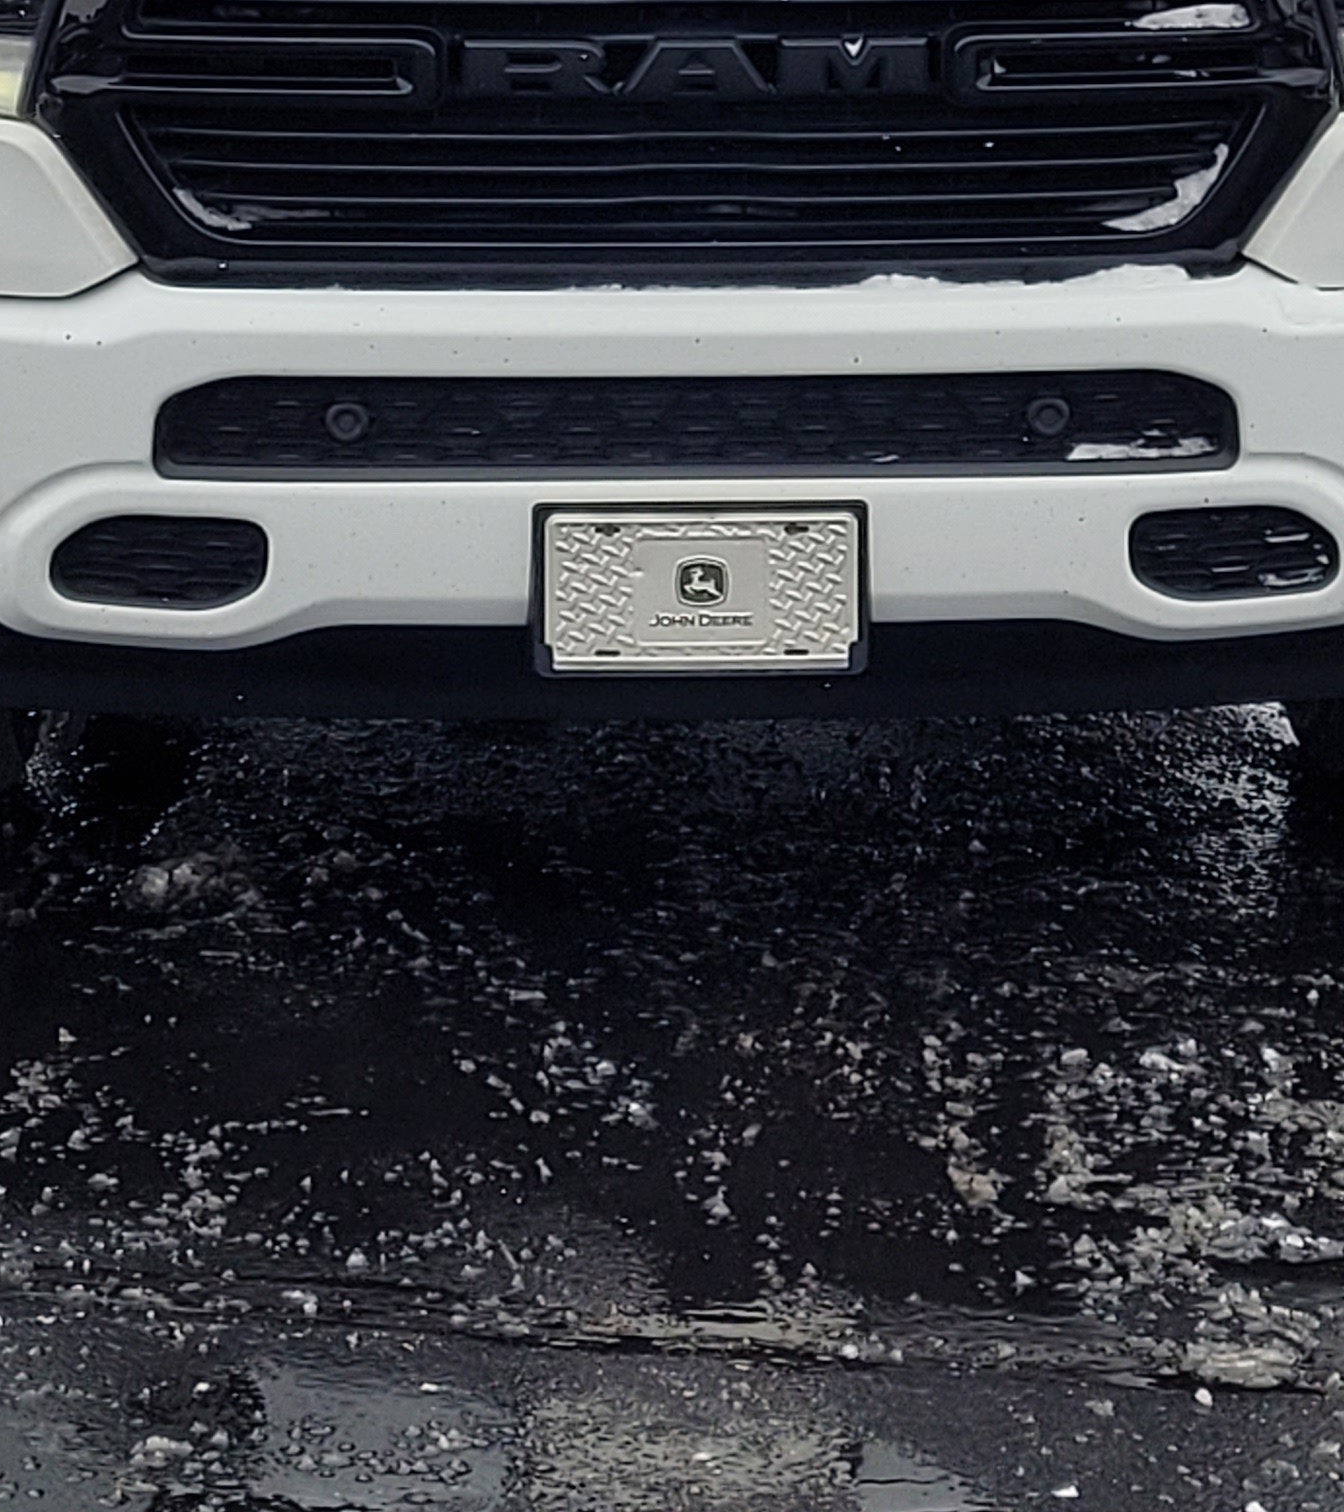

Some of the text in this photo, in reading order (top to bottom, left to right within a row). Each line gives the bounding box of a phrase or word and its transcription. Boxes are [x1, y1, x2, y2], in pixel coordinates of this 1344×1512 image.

[461, 37, 928, 94] RAM
[648, 613, 754, 627] JOHN DEERE
